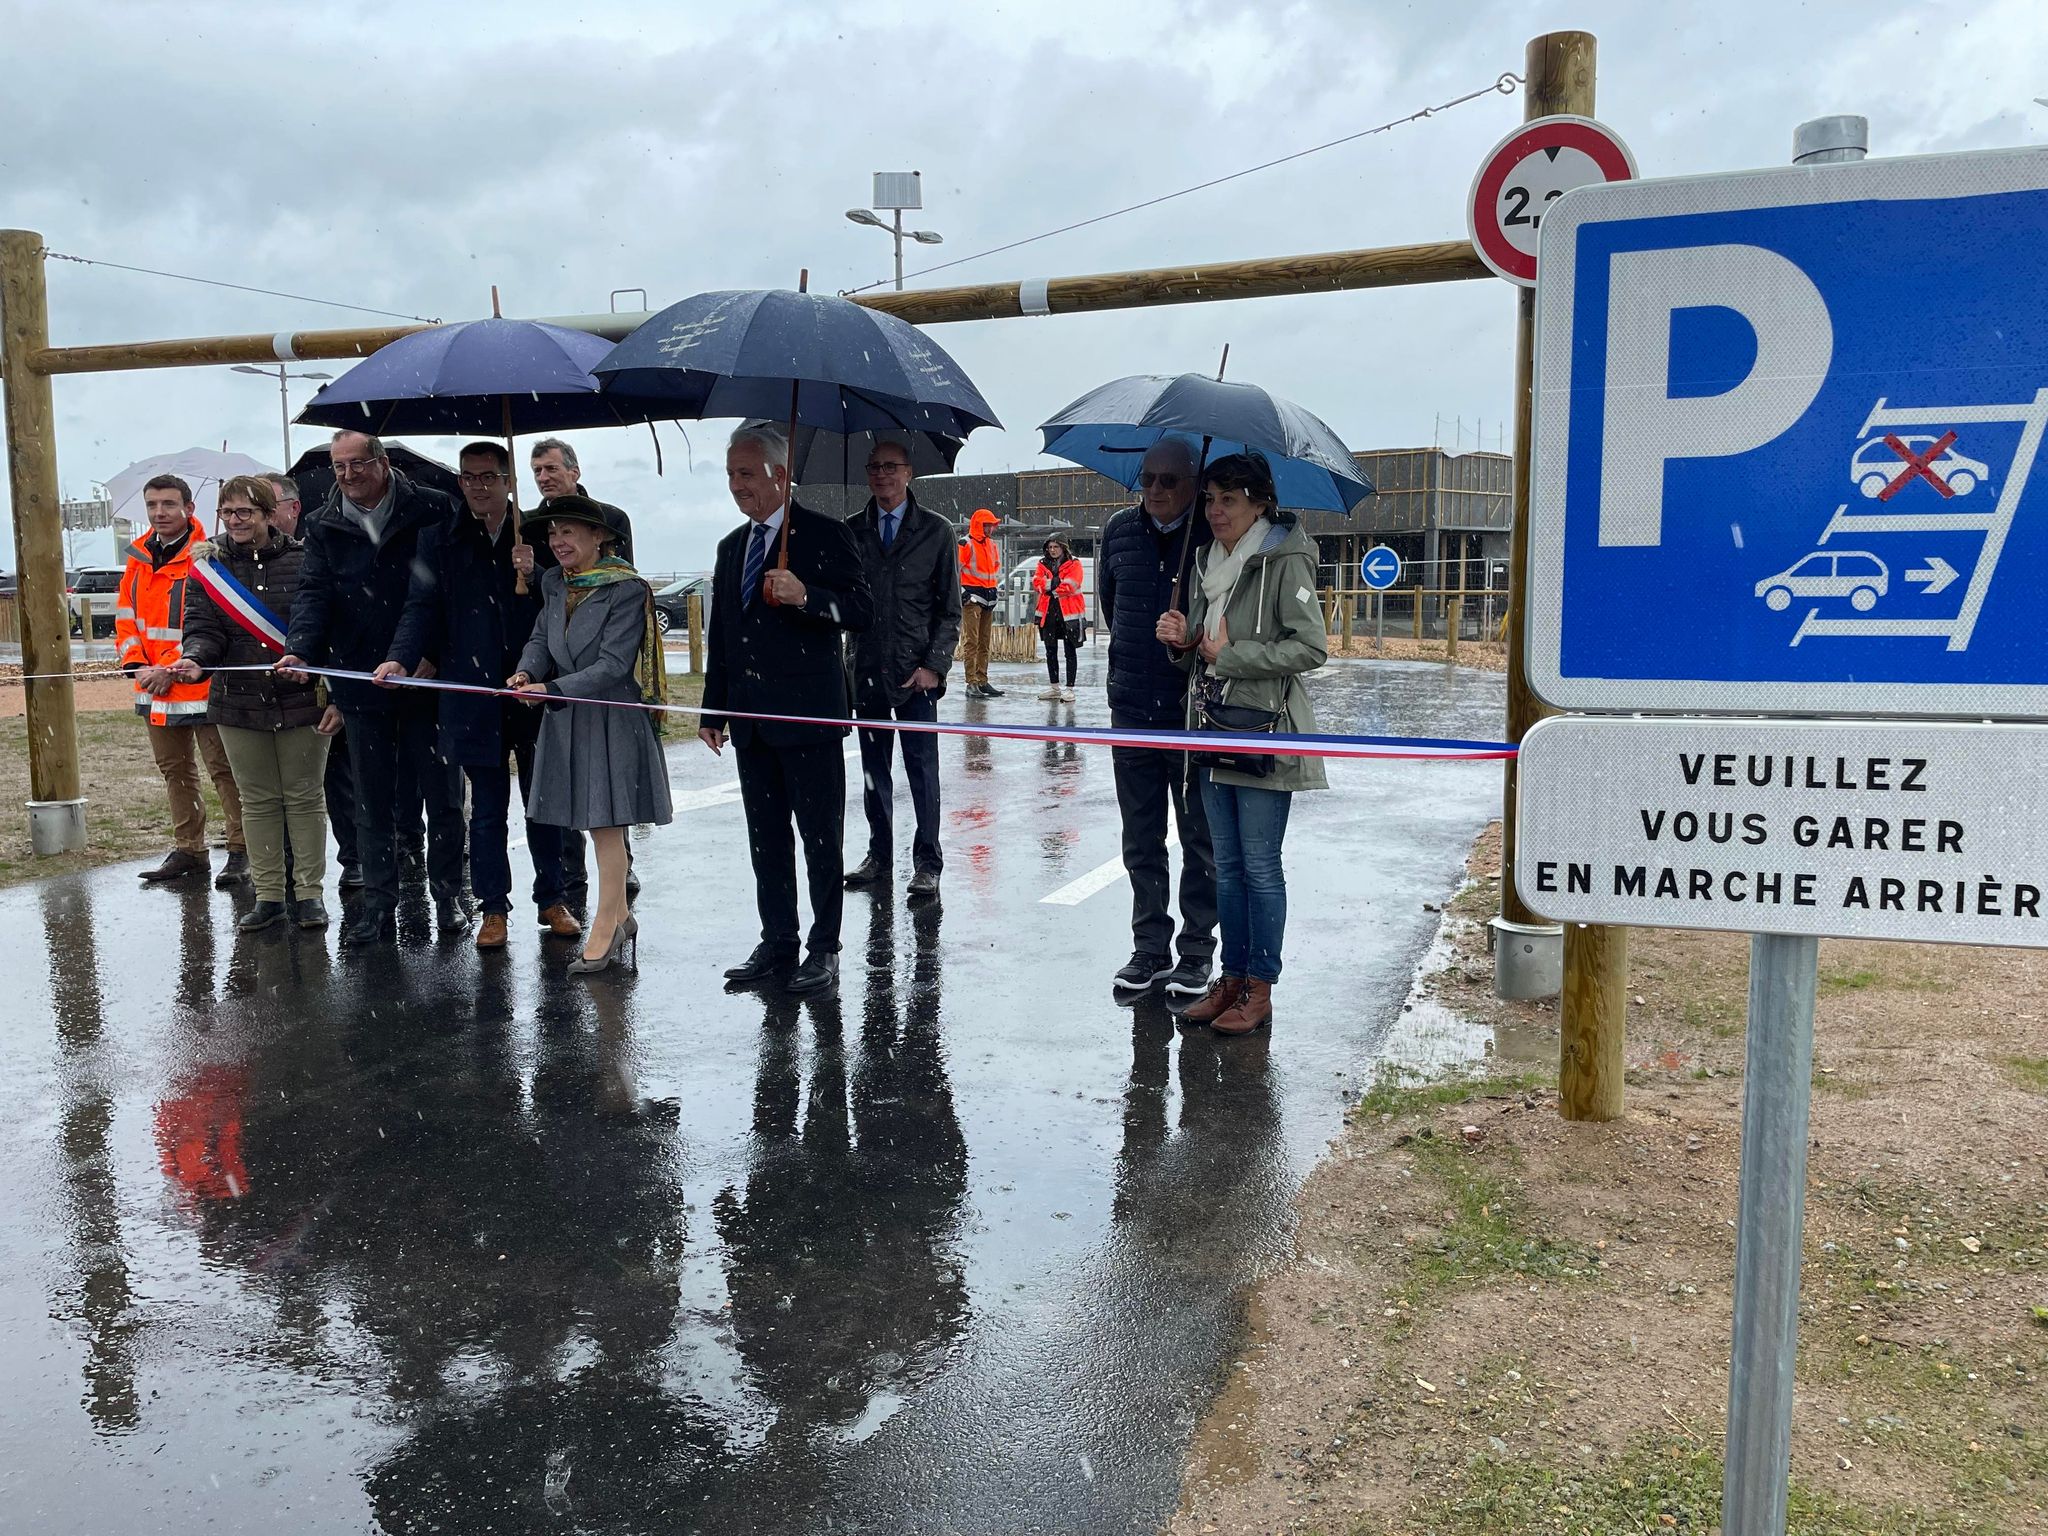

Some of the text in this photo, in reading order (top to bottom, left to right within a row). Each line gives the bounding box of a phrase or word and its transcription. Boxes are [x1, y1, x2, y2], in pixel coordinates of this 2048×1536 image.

[1599, 243, 1834, 547] P
[1679, 753, 1927, 792] VEUILLEZ
[1641, 809, 1964, 854] VOUS GARER
[1537, 861, 2041, 918] EN MARCHE ARRIÈR
